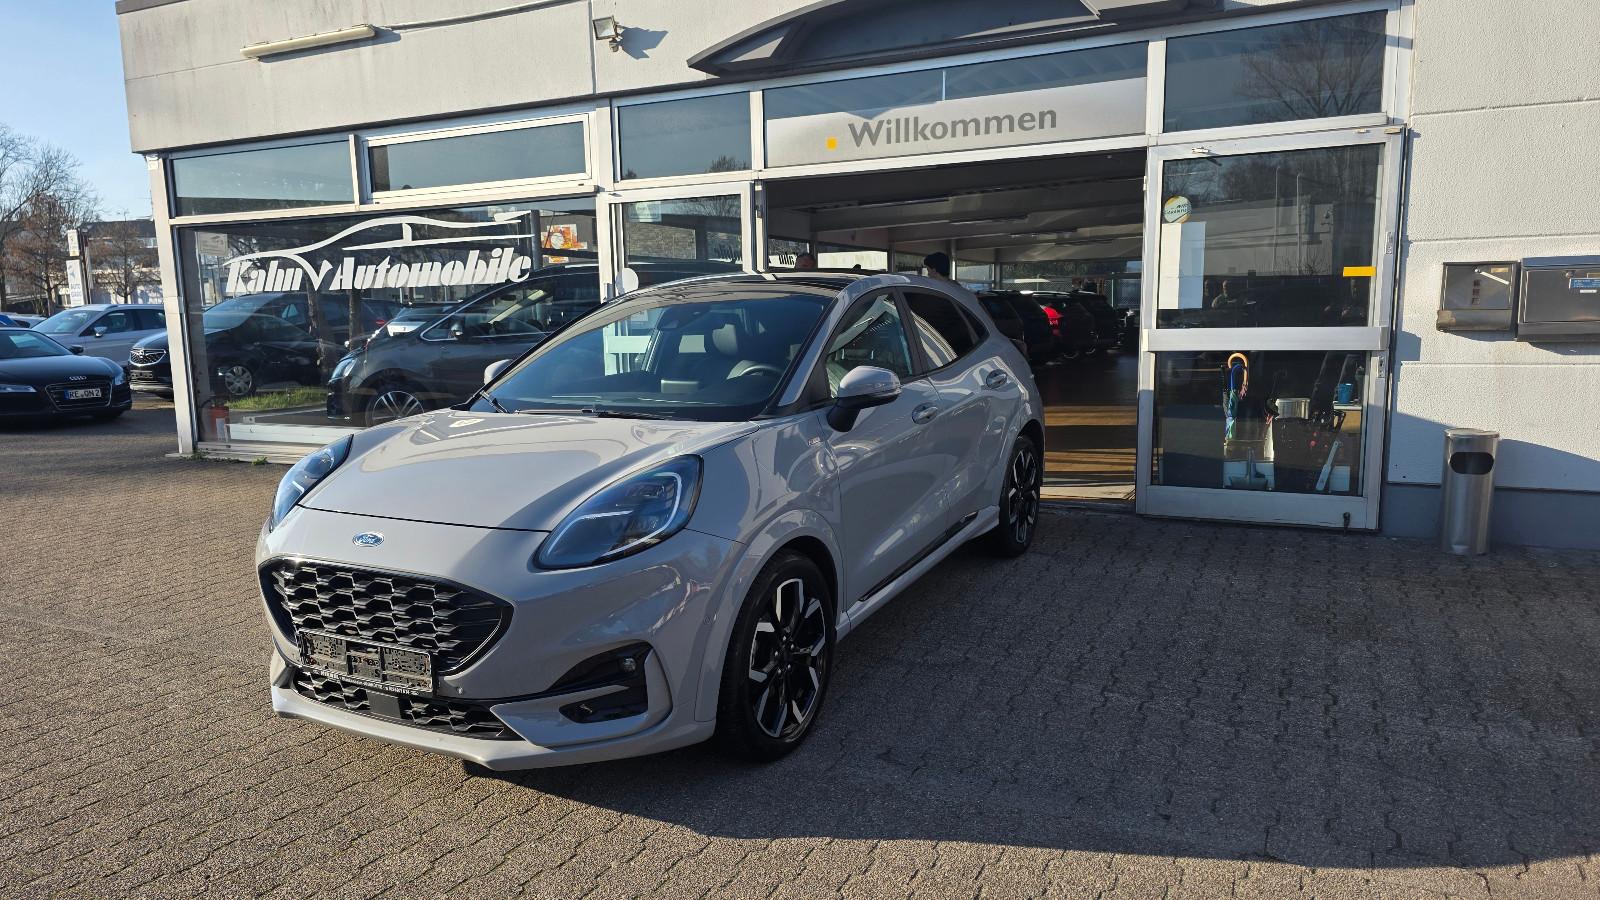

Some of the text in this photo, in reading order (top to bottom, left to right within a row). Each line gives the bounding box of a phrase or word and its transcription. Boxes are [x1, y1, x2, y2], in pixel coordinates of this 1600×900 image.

[847, 108, 1058, 148] Willkommen
[225, 247, 533, 293] Kahn Automobile
